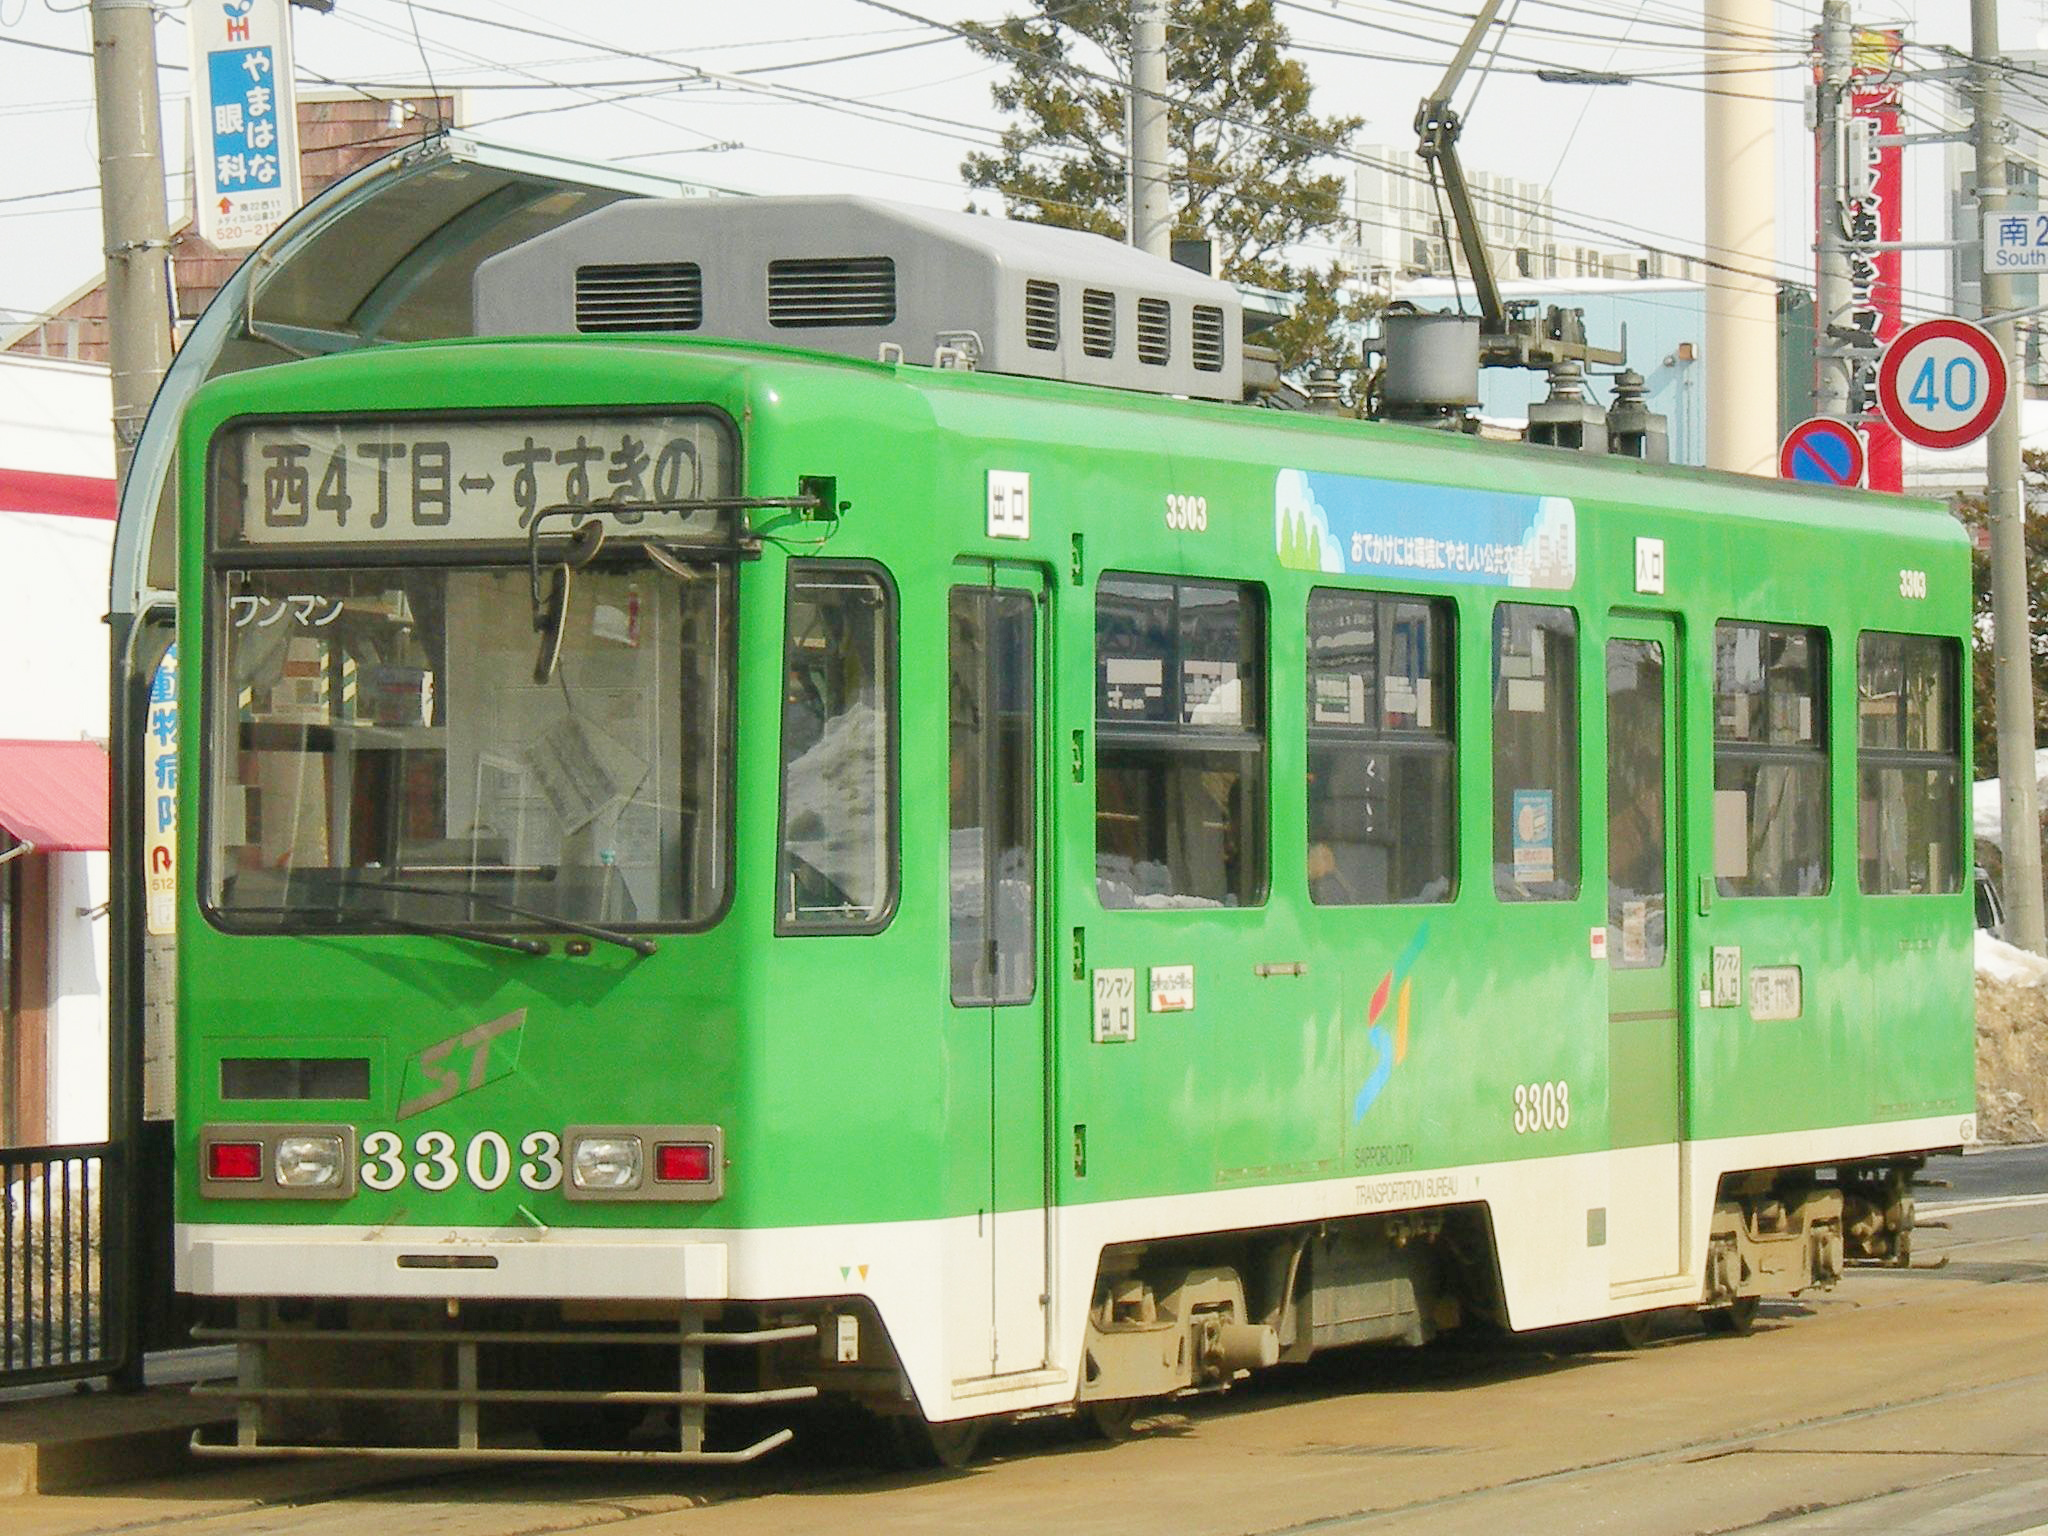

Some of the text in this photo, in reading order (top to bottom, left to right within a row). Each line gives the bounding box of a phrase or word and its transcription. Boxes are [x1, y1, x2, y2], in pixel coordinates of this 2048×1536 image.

[242, 50, 276, 183] やまはな
[215, 103, 247, 186] 眼科
[1996, 249, 2046, 266] South
[1909, 357, 1977, 412] 40
[262, 435, 701, 529] 西4丁目 すすきの
[993, 486, 1024, 523] 出口
[1166, 494, 1207, 531] 3303
[1639, 550, 1660, 580] 入口
[1900, 569, 1926, 599] 3303
[231, 594, 344, 628] ワンマン
[1097, 976, 1133, 998] ワンマン
[1102, 1007, 1129, 1031] 出口
[1513, 1080, 1569, 1134] 3303
[359, 1129, 564, 1193] 3303
[1355, 1143, 1414, 1169] SAPPORO CITY
[1355, 1176, 1459, 1205] TRANSPORTATION BUREAU
